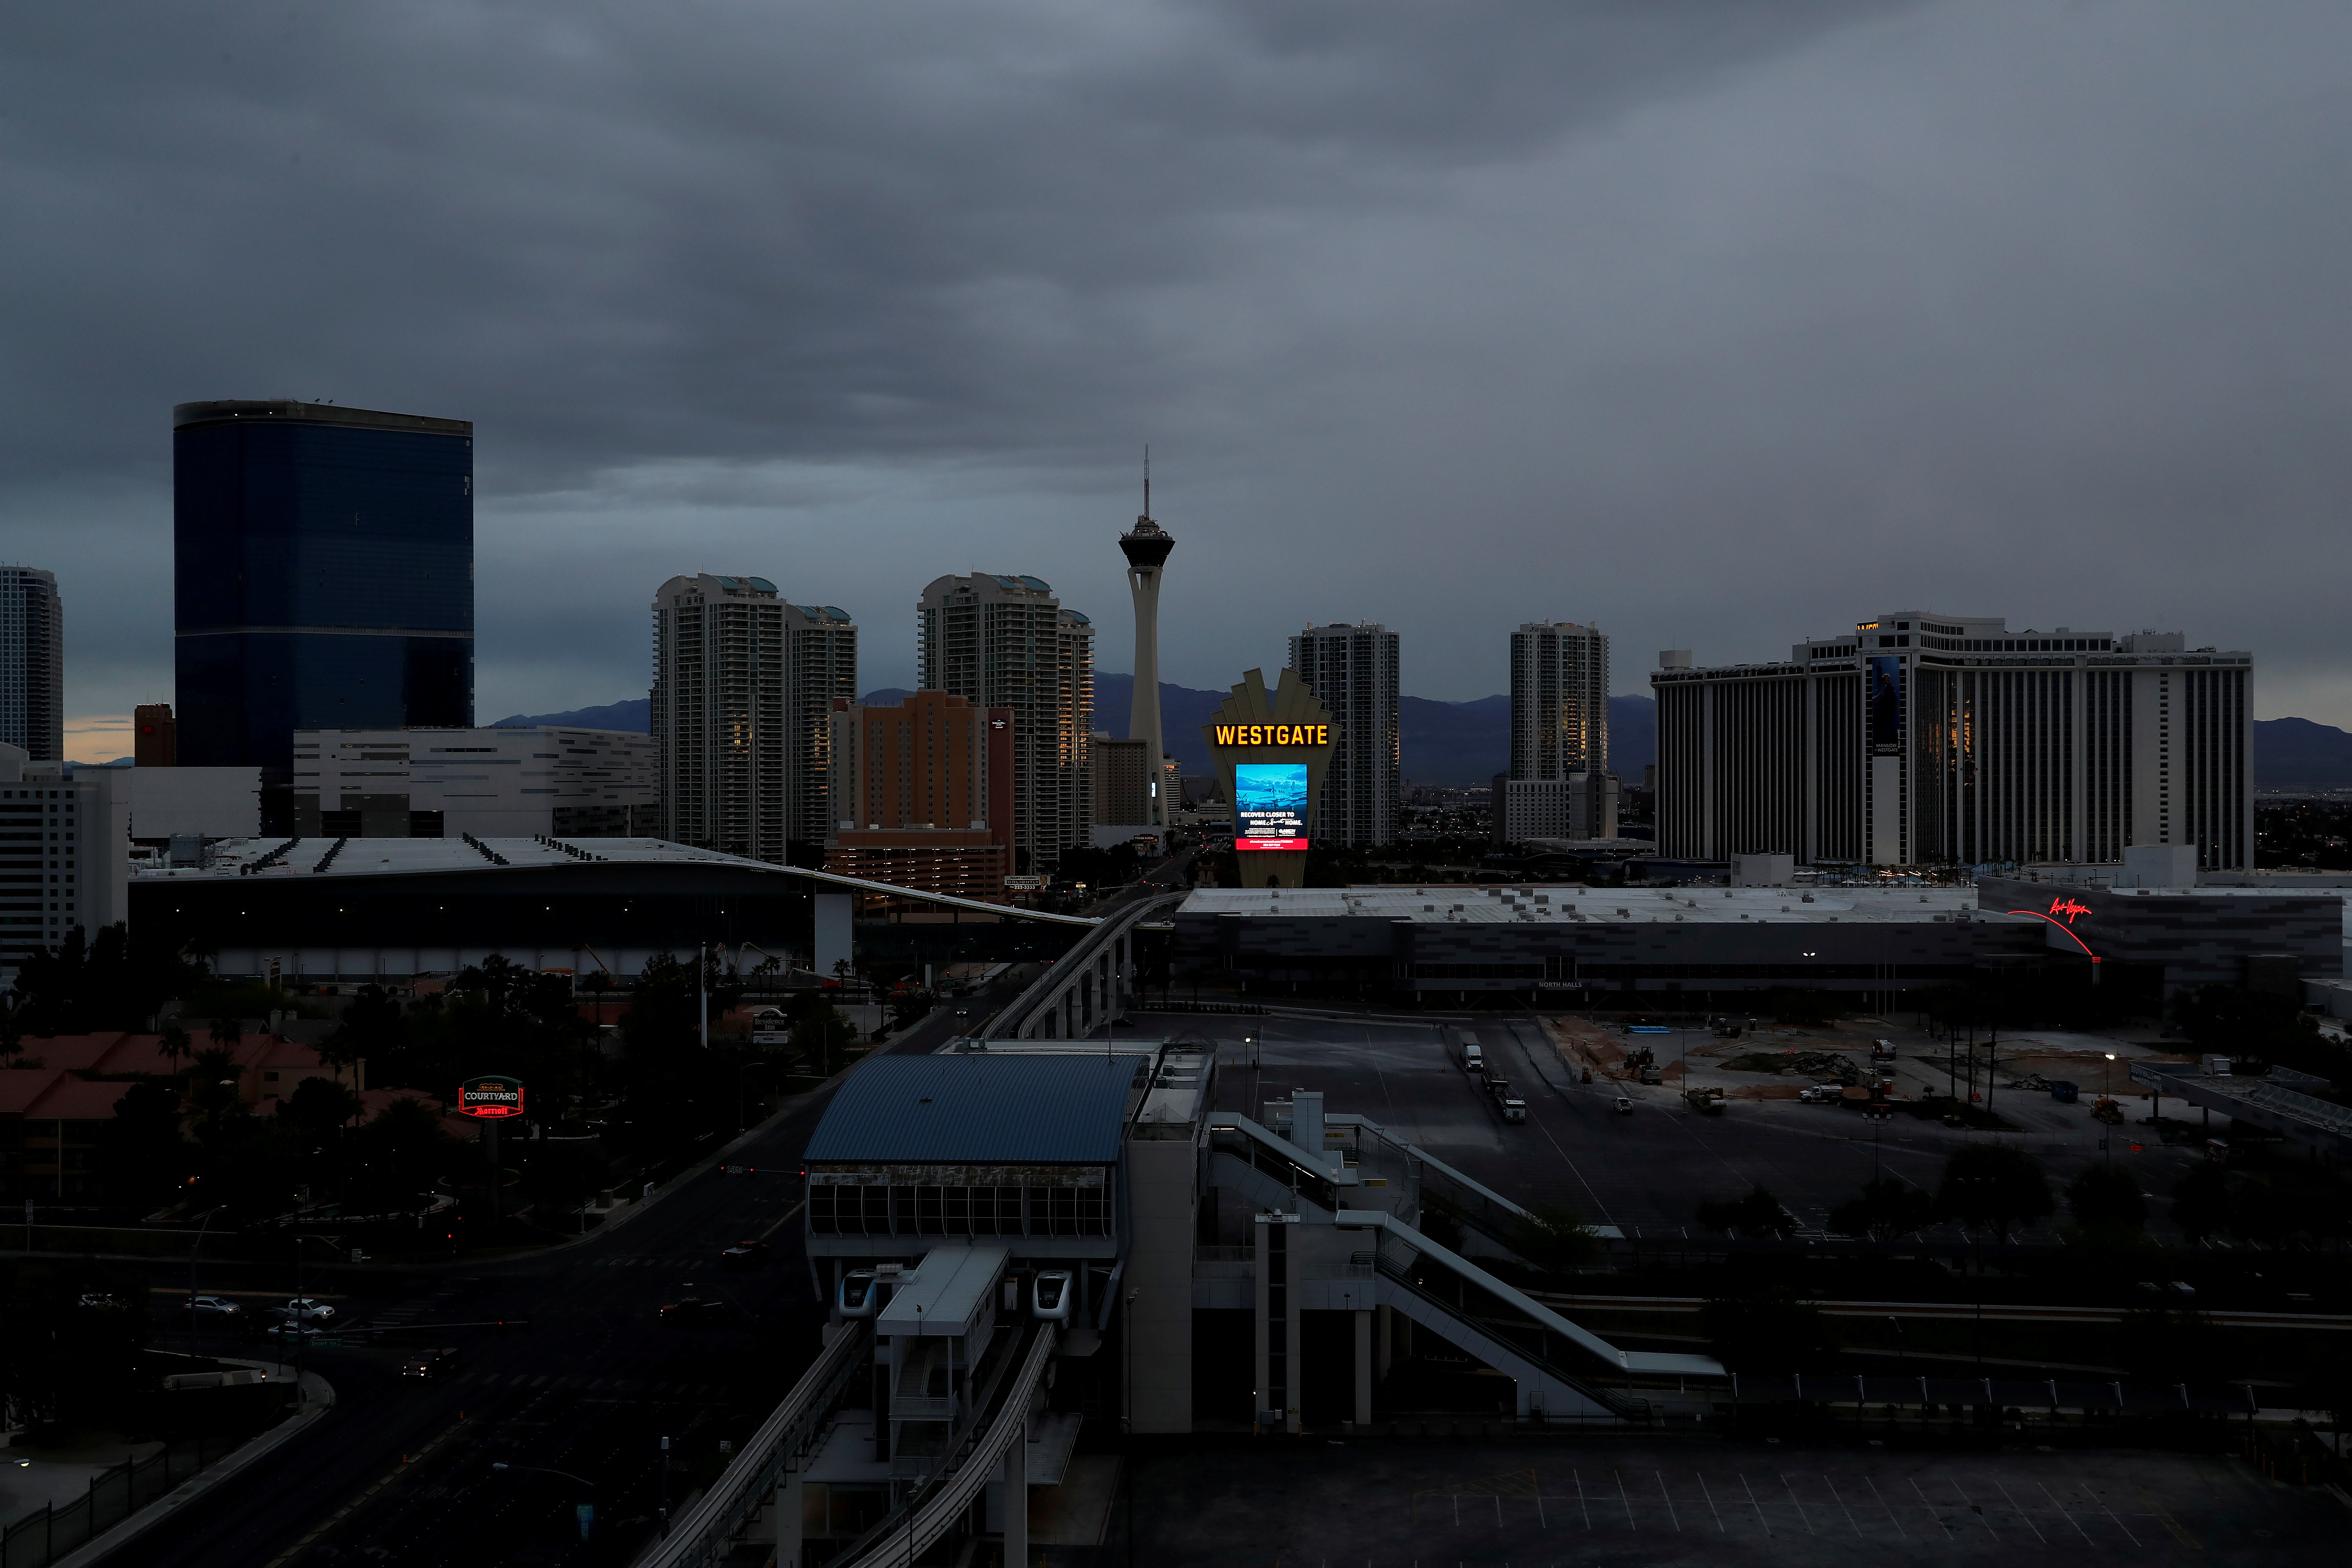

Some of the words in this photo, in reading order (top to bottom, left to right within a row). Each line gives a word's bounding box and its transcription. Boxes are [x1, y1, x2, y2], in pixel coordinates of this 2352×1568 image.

[1216, 726, 1327, 744] WESTGATE
[2049, 897, 2068, 915] Las
[2066, 898, 2093, 924] Vegas
[464, 1092, 518, 1100] COURTYARD
